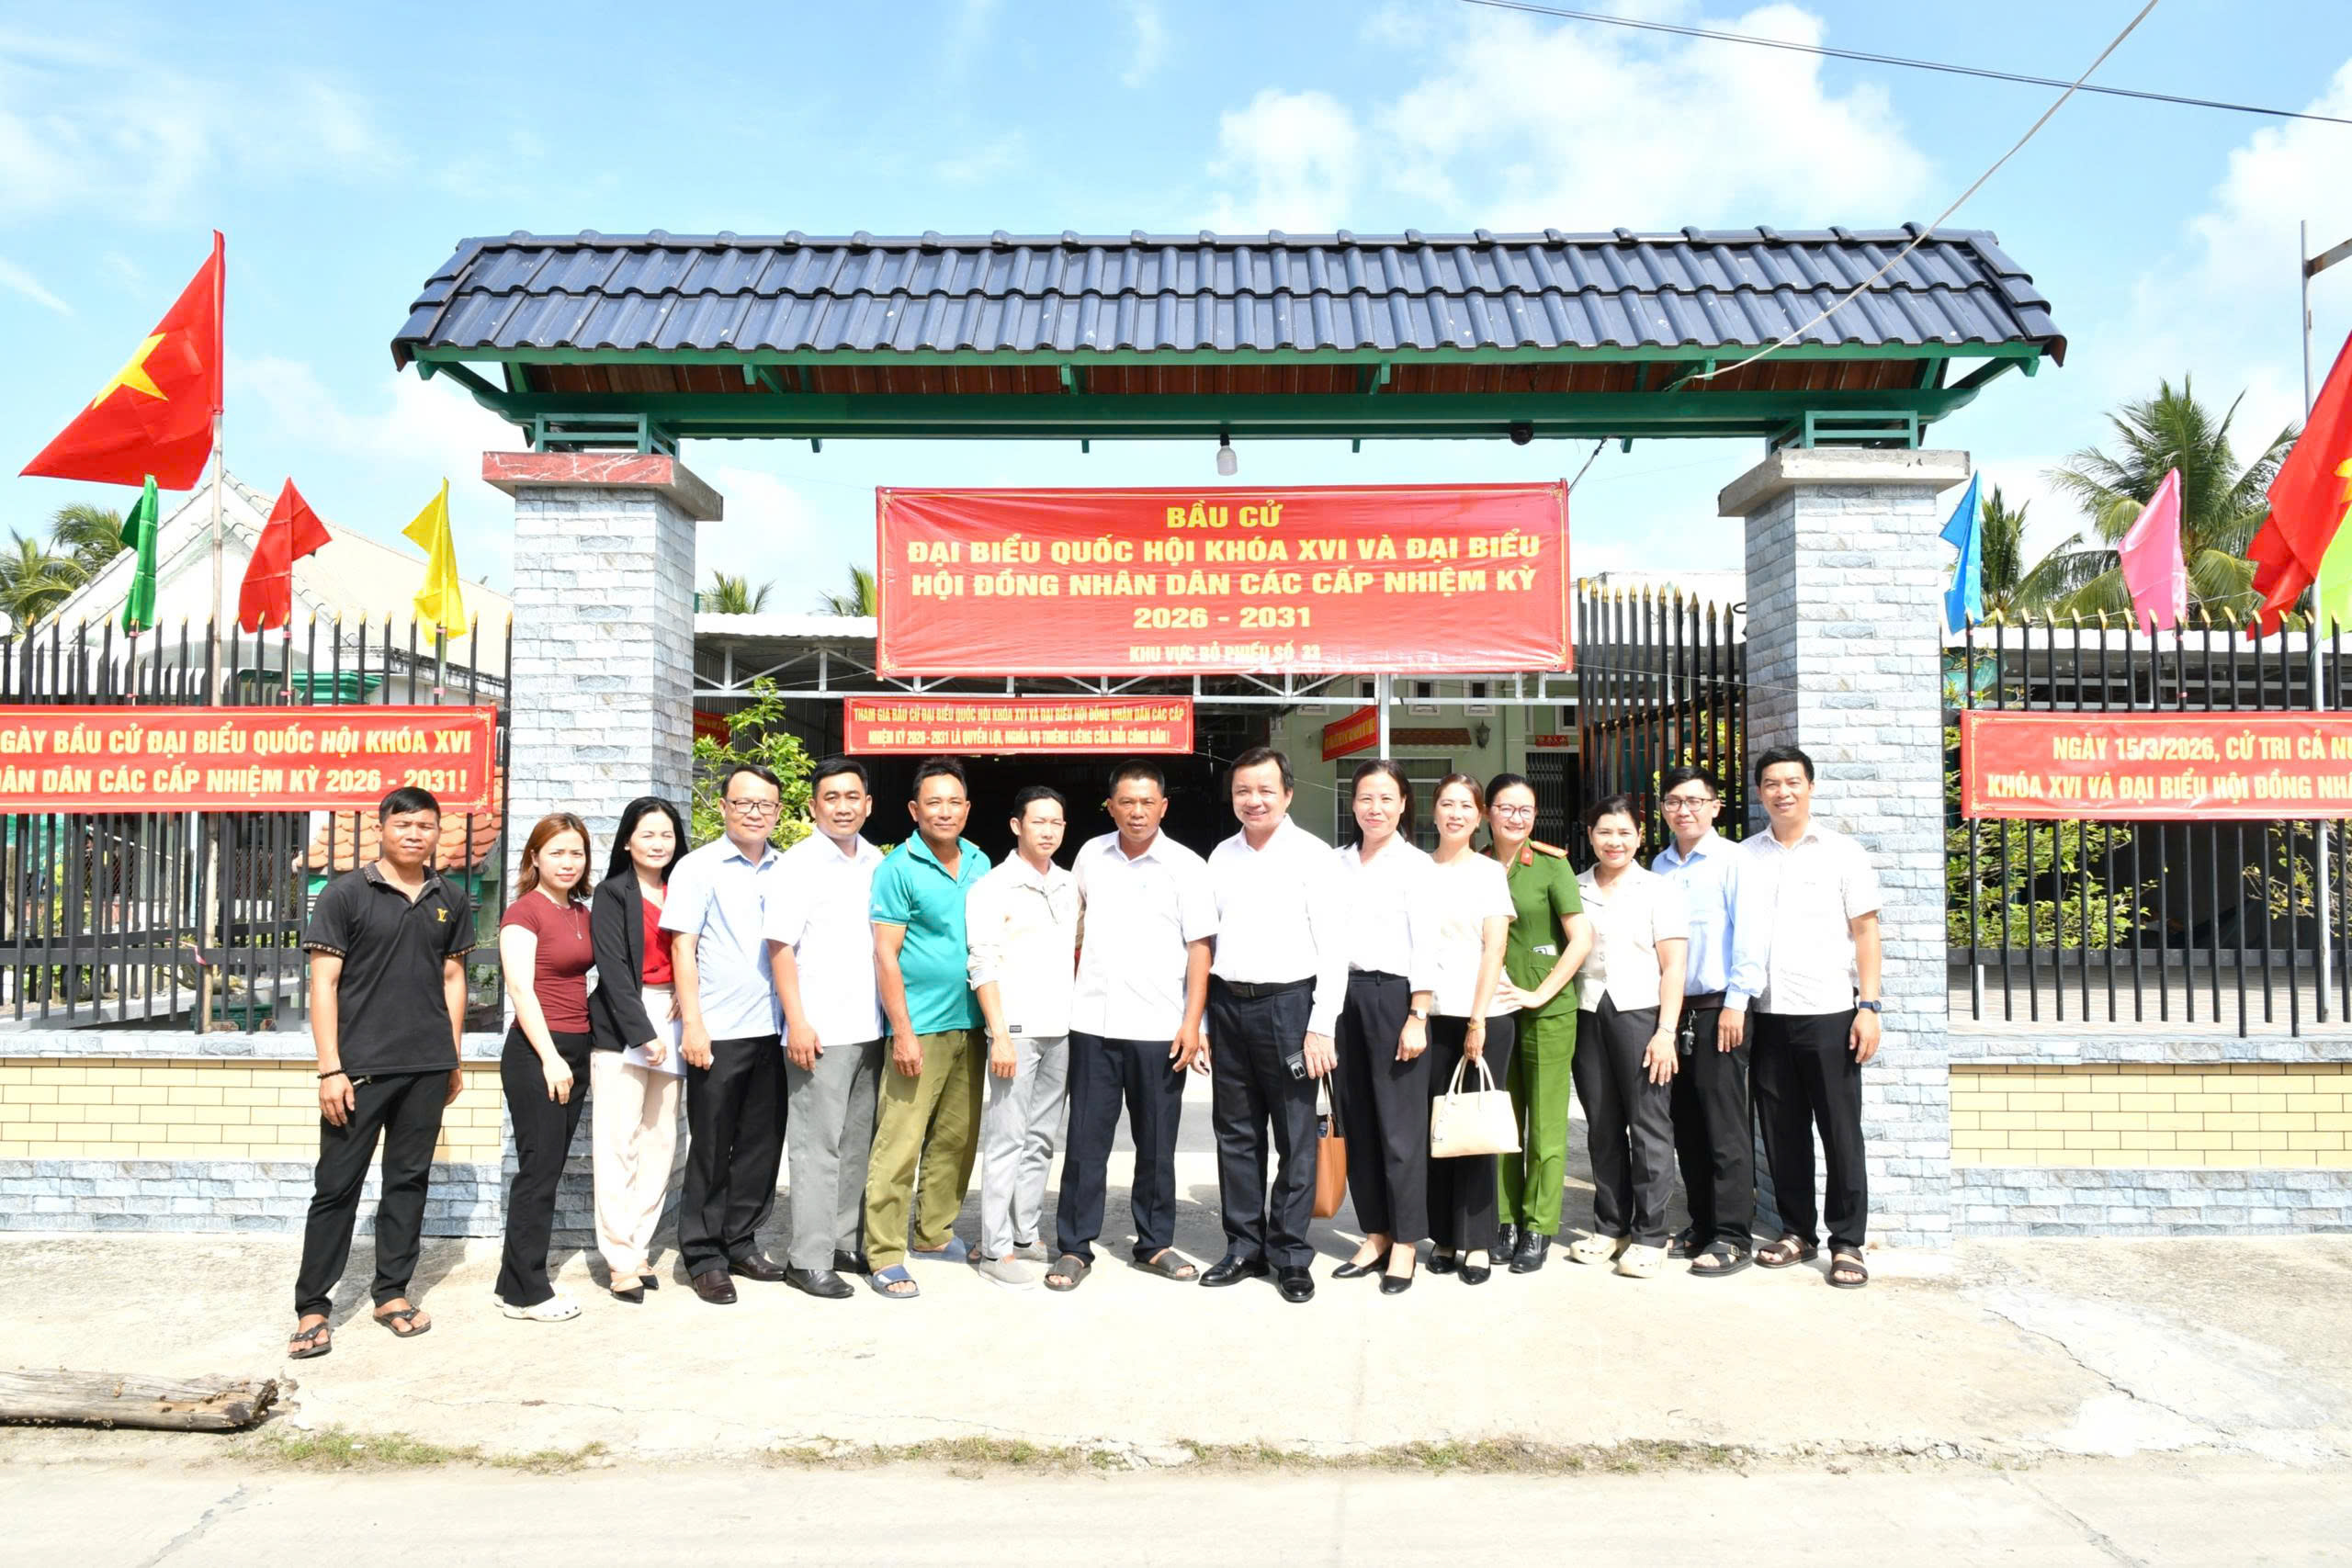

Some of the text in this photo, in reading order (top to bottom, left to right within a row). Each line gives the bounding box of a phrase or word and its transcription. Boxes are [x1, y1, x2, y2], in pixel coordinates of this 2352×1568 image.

[1167, 500, 1283, 528] BẦU CỬ
[908, 541, 960, 567] ĐẠI
[1051, 534, 1133, 565] QUỐC
[1144, 536, 1195, 566] HỘI
[1204, 536, 1288, 561] KHÓA
[1297, 538, 1347, 561] XVI
[1357, 534, 1397, 560] VÀ
[1406, 537, 1458, 563] ĐẠI
[1468, 528, 1540, 558] BIỂU
[911, 570, 964, 600] HỘI
[1069, 570, 1156, 595] NHÂN
[1166, 570, 1230, 595] DÂN
[1240, 569, 1302, 594] CÁC
[1312, 566, 1374, 593] CẤP
[1384, 567, 1486, 596] NHIỆM
[1497, 565, 1536, 591] KỲ
[1133, 607, 1208, 628] 2026
[1239, 606, 1310, 628] 2031
[1129, 646, 1161, 662] KHU
[1273, 640, 1294, 662] SỐ
[108, 722, 143, 753] CỬ
[146, 730, 187, 759] ĐẠI
[193, 720, 247, 753] BIỂU
[253, 722, 314, 756] QUỐC
[320, 725, 360, 758] HỘI
[365, 725, 428, 753] KHÓA
[434, 730, 471, 753] XVI
[2052, 732, 2108, 761] NGÀY
[2115, 737, 2221, 763] 15/3/2026,
[2225, 728, 2256, 761] CỬ
[2258, 737, 2291, 760] TRI
[2297, 728, 2326, 760] CẢ
[0, 764, 36, 793] ÂN
[41, 764, 92, 793] DÂN
[98, 764, 146, 793] CÁC
[153, 761, 200, 793] CẤP
[206, 764, 284, 798] NHIỆM
[288, 764, 321, 793] KỲ
[325, 769, 381, 793] 2026
[1986, 770, 2044, 798] KHÓA
[2048, 775, 2082, 799] XVI
[2087, 772, 2113, 799] VÀ
[2119, 775, 2154, 805] ĐẠI
[2160, 767, 2207, 799] BIỂU
[2212, 772, 2250, 805] HỘI
